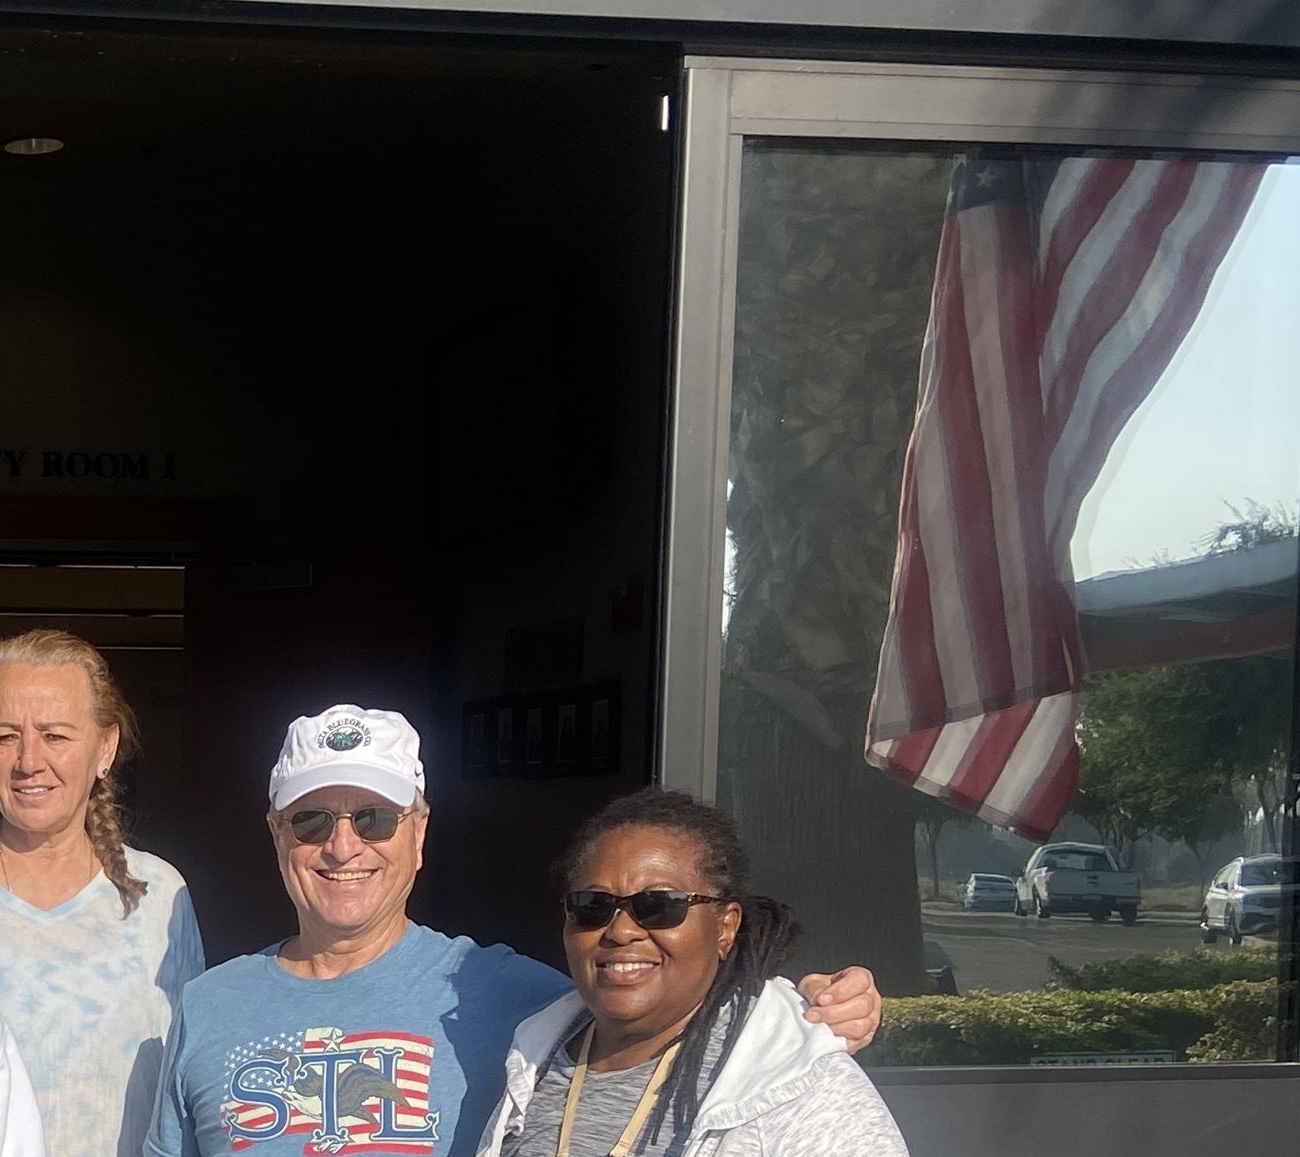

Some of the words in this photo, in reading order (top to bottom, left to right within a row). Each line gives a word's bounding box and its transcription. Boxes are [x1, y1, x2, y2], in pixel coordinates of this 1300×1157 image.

[42, 452, 149, 480] ROOM
[164, 454, 175, 480] 1
[328, 719, 371, 735] BLUEGRASS
[225, 1047, 441, 1142] STL
